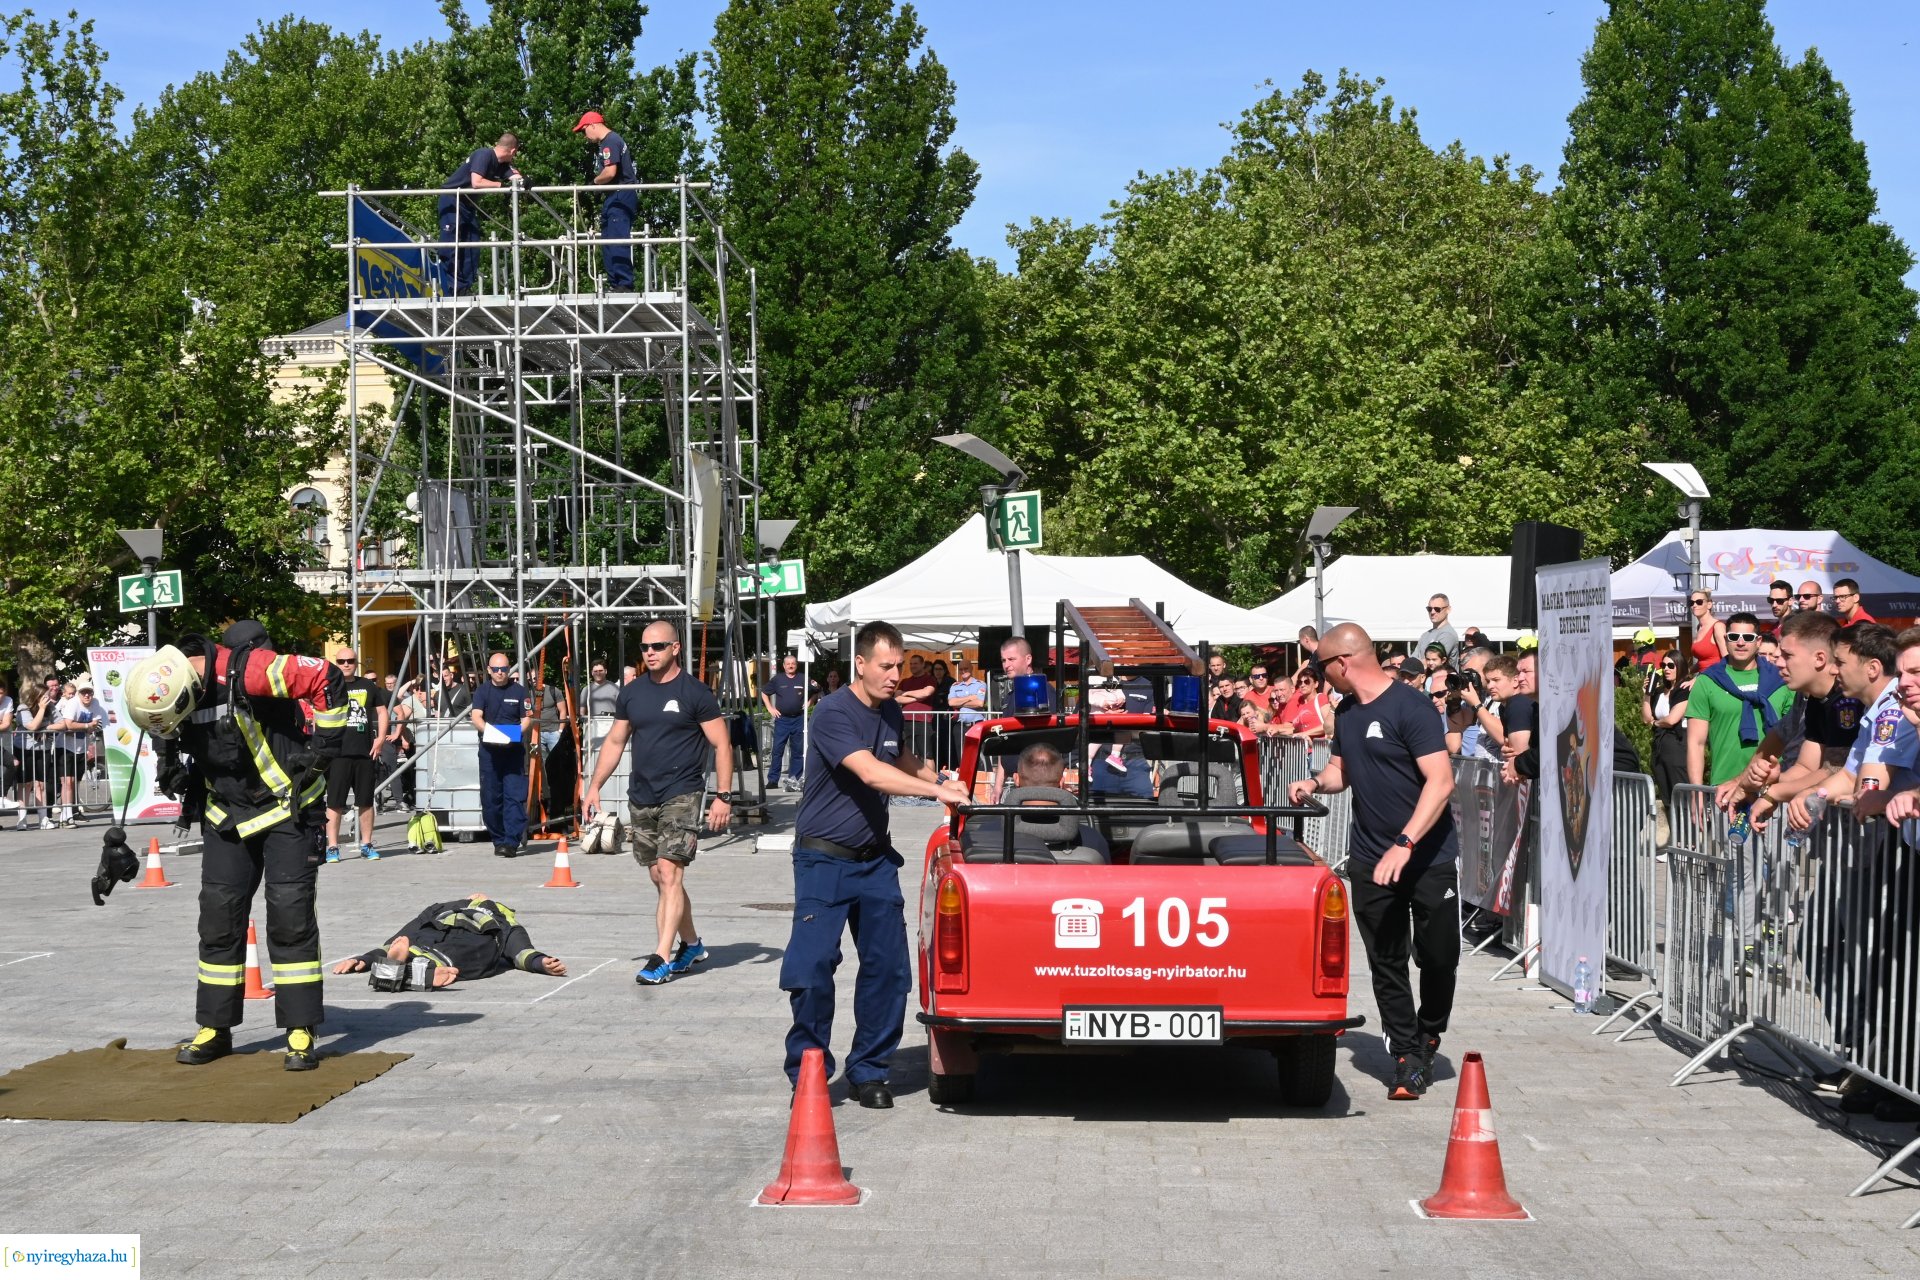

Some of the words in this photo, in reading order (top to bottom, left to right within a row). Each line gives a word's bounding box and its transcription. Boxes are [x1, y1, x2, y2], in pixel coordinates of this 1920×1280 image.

[1541, 591, 1564, 610] MAGYAR
[1121, 896, 1230, 948] 105
[1034, 963, 1247, 981] www.tuzoltosag-nyirbator.hu
[1070, 1025, 1081, 1037] H
[1088, 1012, 1216, 1038] NYB-001
